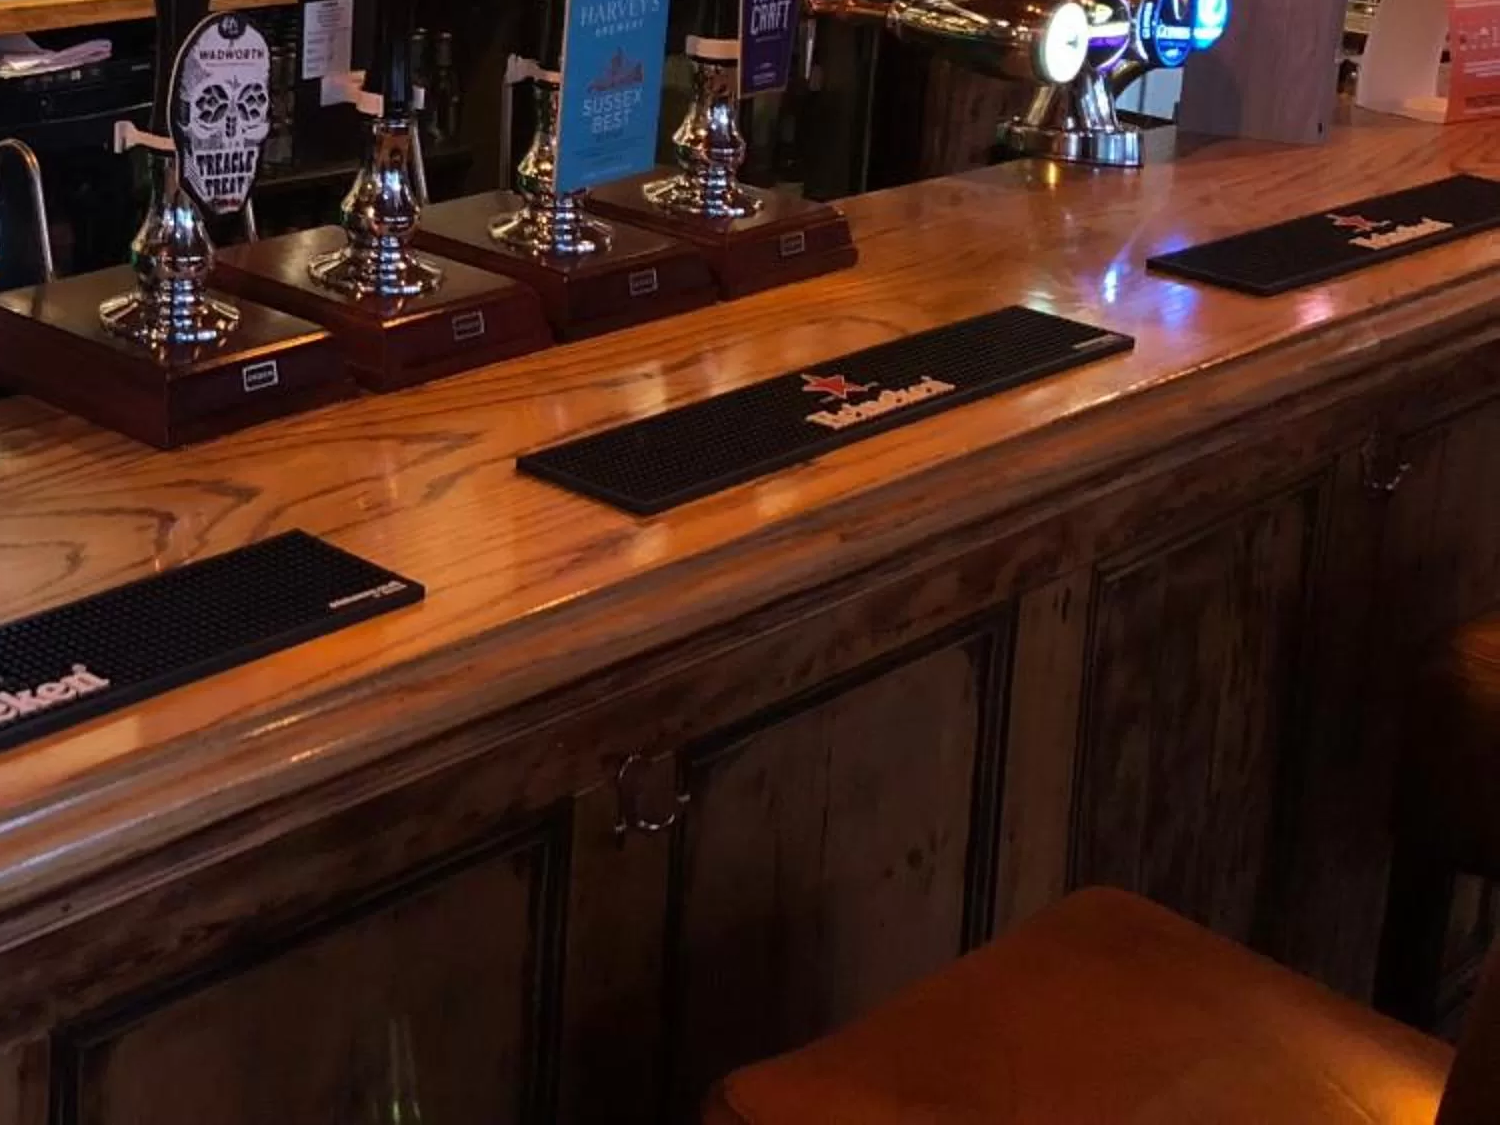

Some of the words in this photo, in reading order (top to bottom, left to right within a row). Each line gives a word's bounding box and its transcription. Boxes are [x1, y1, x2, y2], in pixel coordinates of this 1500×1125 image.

[199, 48, 264, 61] WADWORTH
[582, 86, 643, 117] SUSSEX
[592, 109, 632, 134] BEST
[196, 149, 255, 176] TREACLE
[204, 176, 246, 197] TREAT
